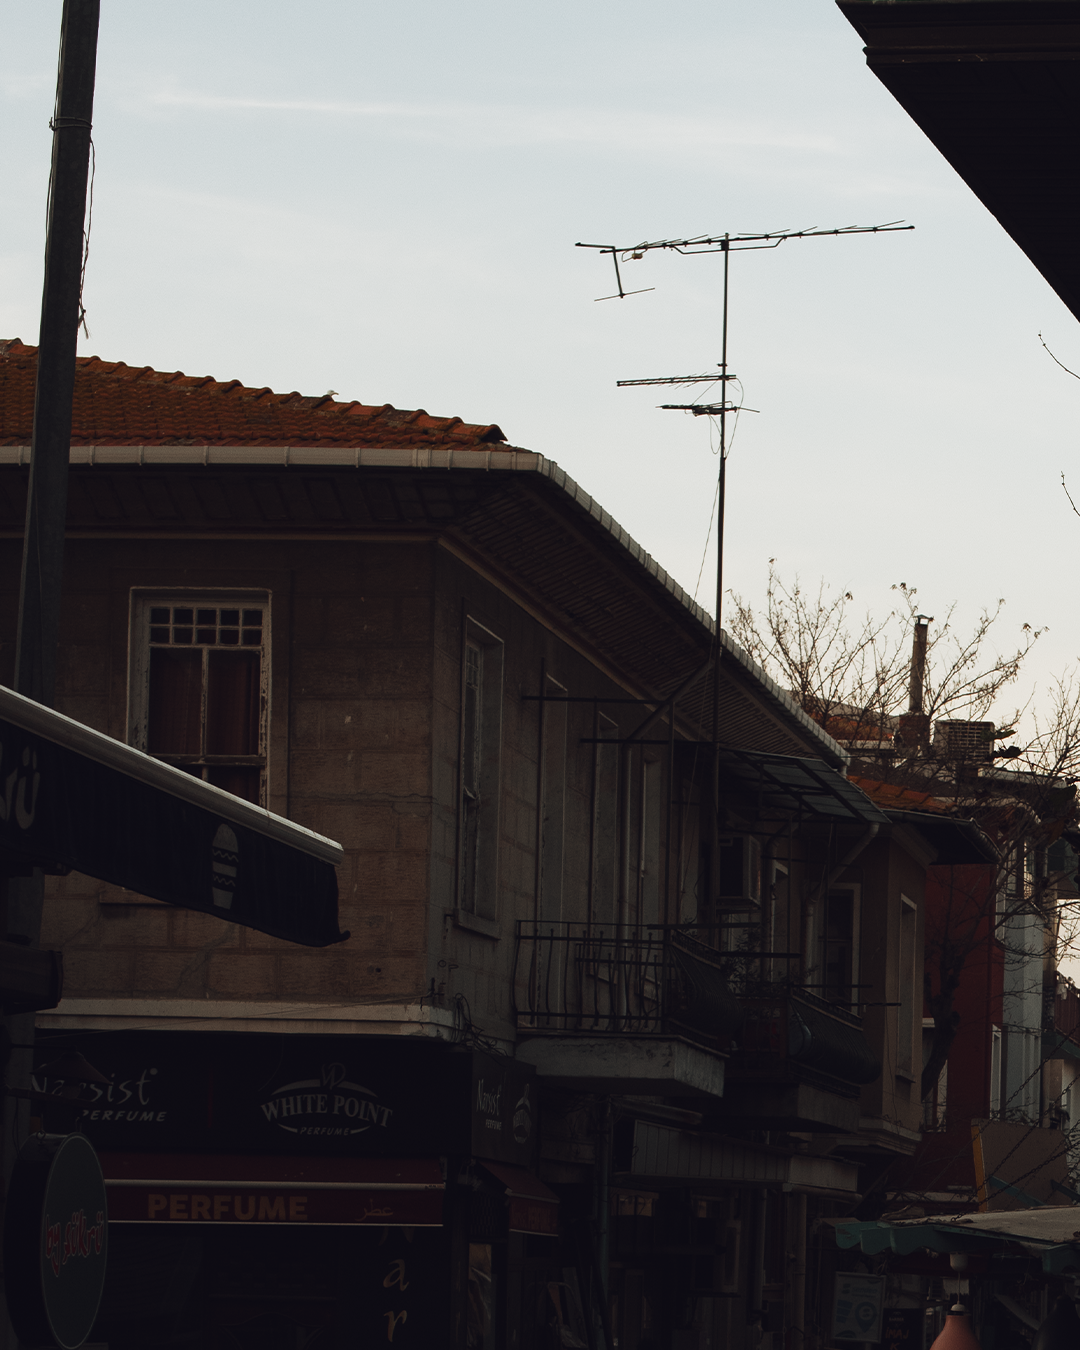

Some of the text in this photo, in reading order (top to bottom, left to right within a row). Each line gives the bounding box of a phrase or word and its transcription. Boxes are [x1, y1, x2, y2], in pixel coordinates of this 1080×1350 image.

[260, 1093, 394, 1128] WHITE POINT
[299, 1126, 350, 1136] PERFUME
[147, 1193, 309, 1221] PERFUME
[355, 1198, 394, 1222] عطر
[46, 1214, 61, 1278] by
